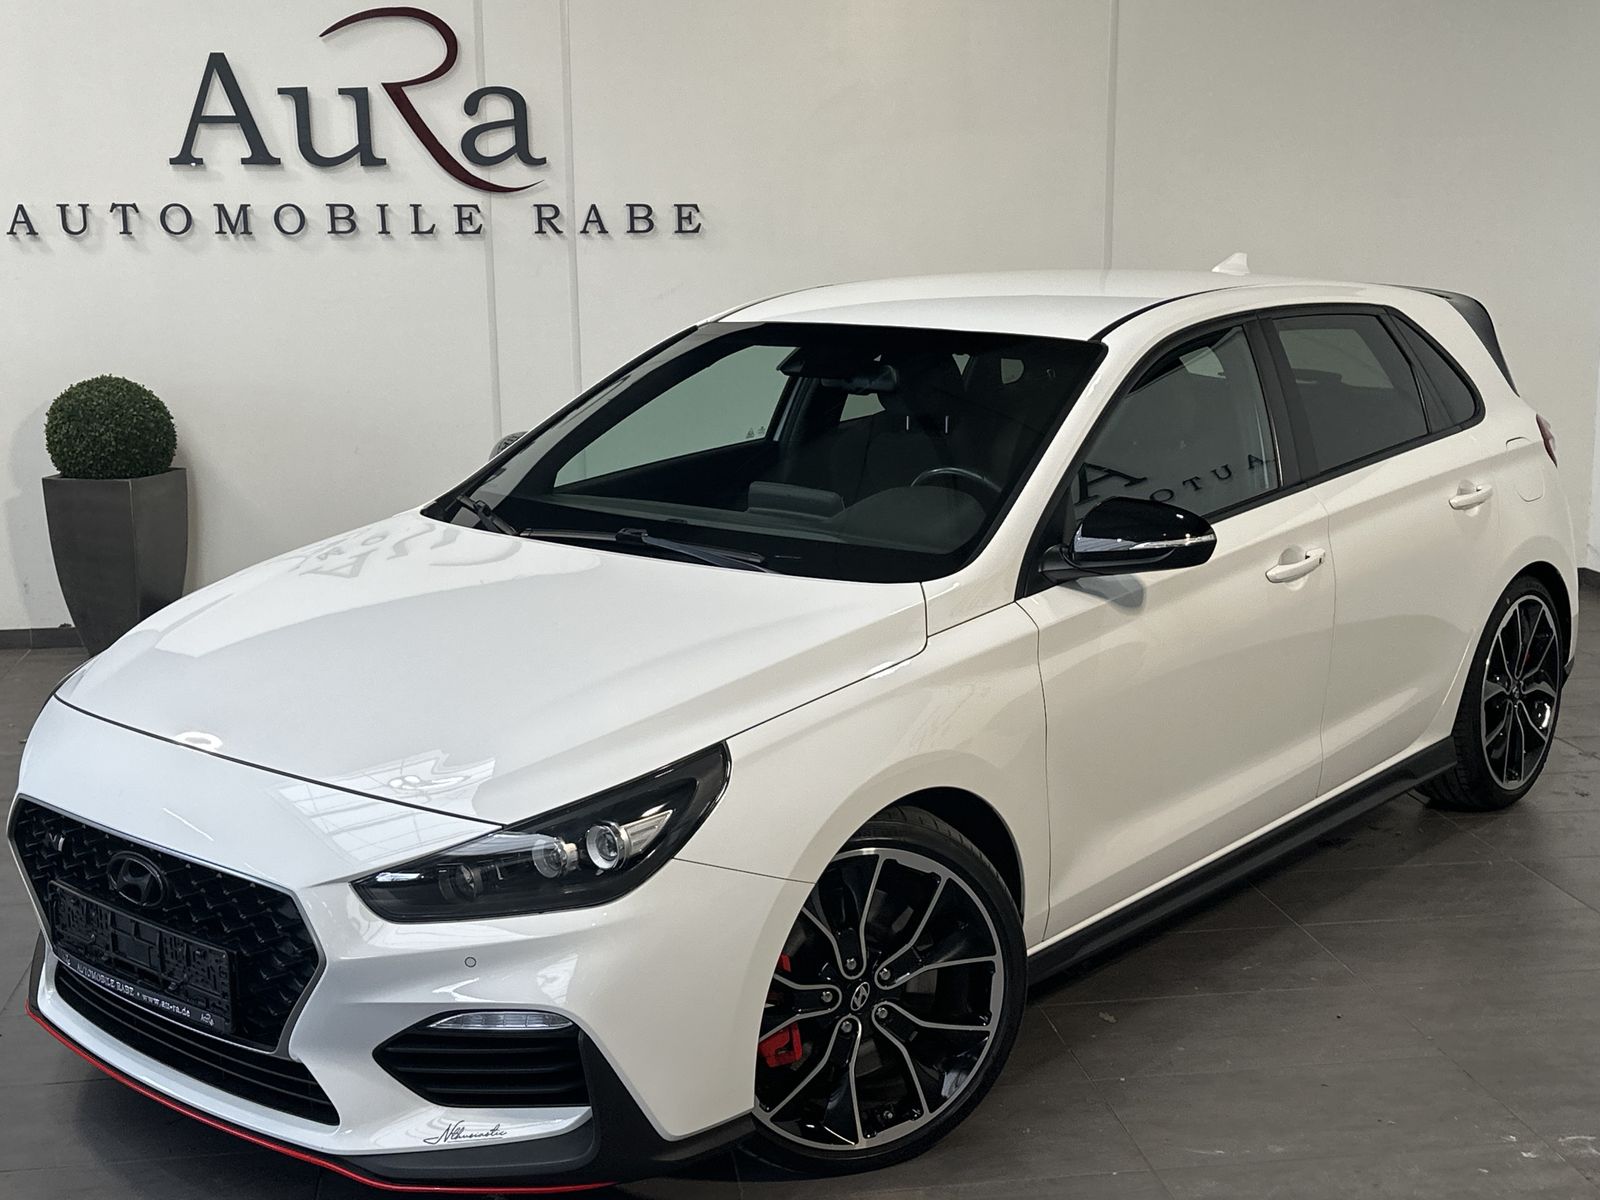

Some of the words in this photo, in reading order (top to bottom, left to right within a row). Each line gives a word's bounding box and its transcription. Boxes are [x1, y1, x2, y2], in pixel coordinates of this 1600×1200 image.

[169, 7, 547, 193] AuRa
[7, 203, 483, 238] AUTOMOBILE
[534, 203, 703, 236] RABE
